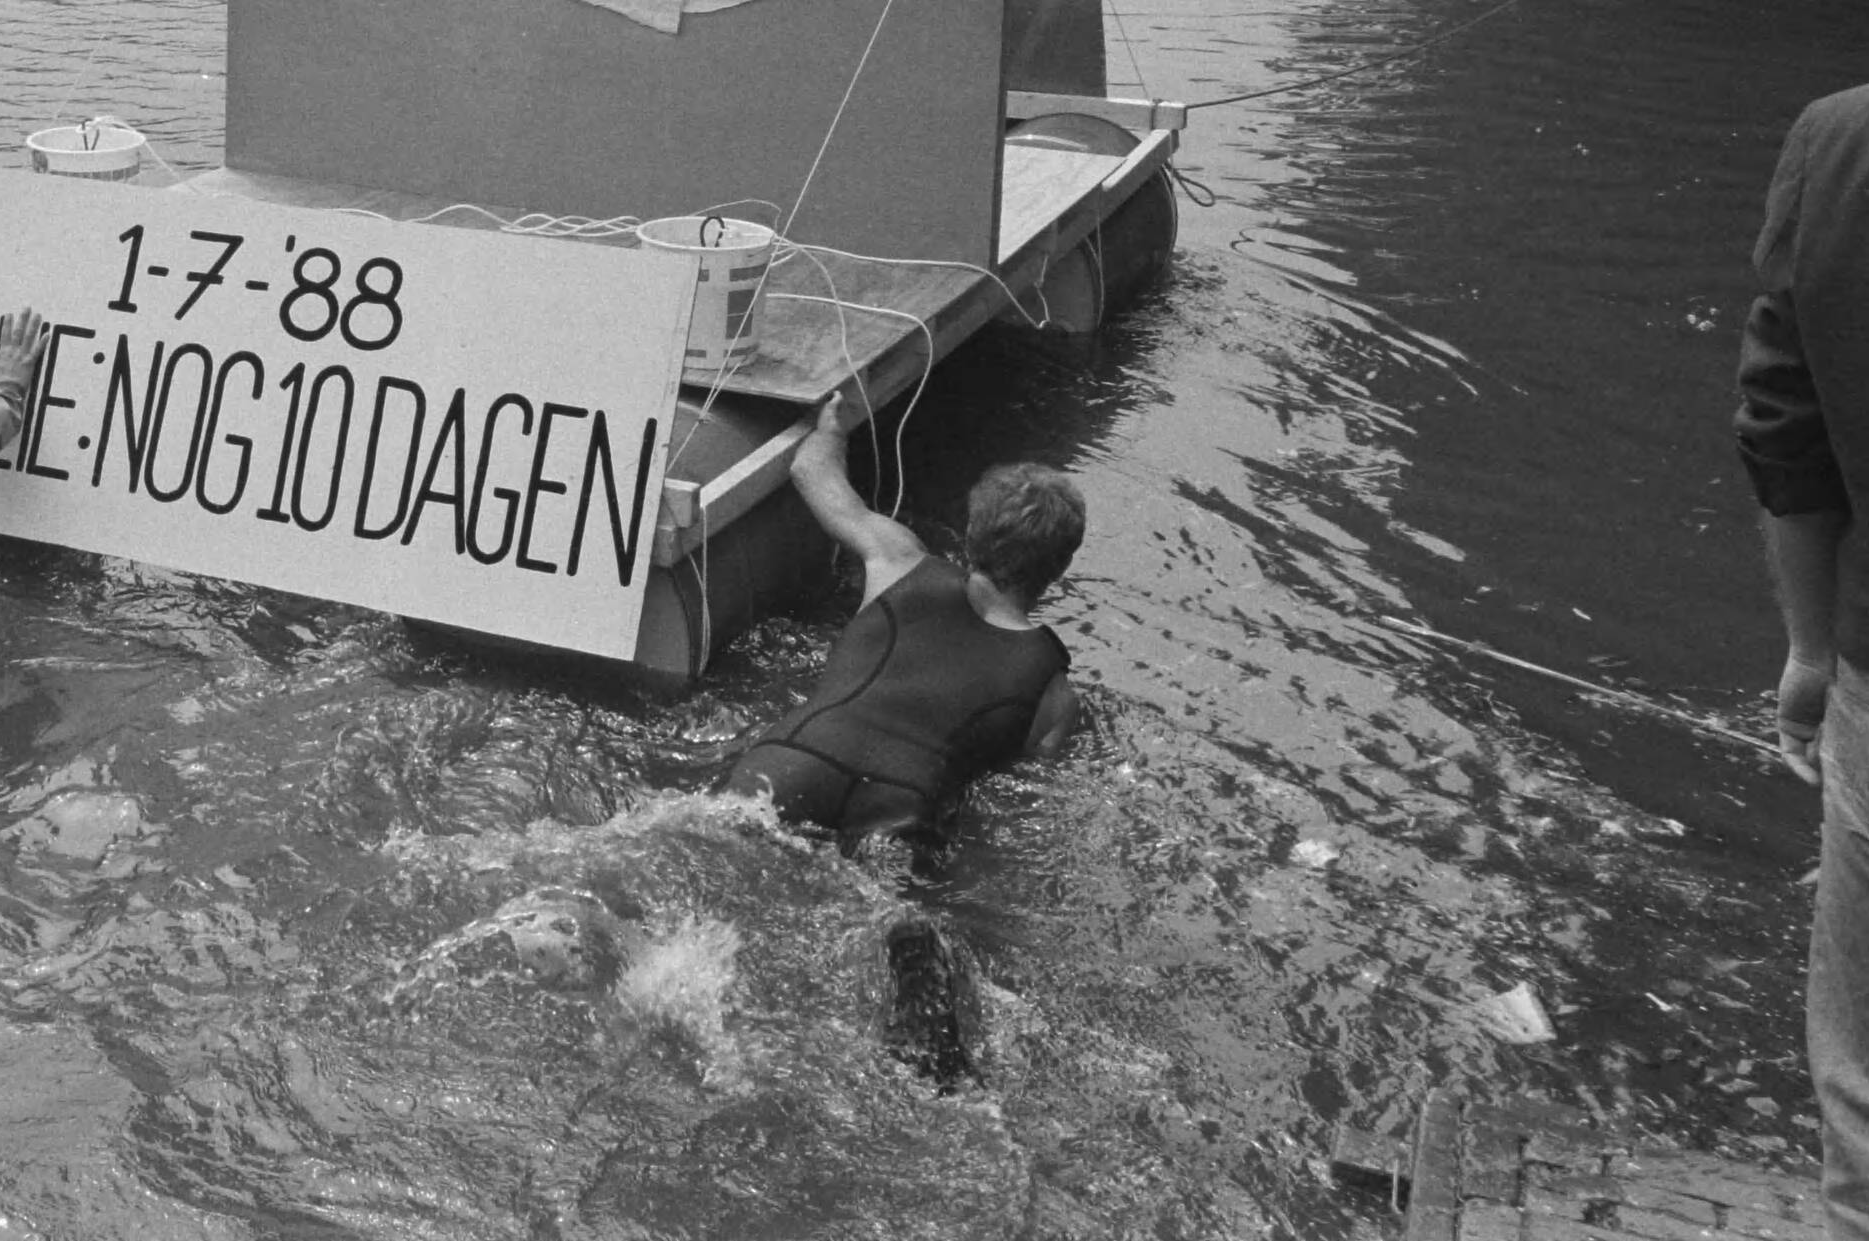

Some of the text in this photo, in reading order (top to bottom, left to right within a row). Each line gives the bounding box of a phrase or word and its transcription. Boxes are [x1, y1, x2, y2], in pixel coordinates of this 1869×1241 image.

[108, 224, 404, 352] 1-7-'88
[91, 334, 265, 515] NOG
[256, 362, 355, 532] 10
[353, 376, 658, 587] DAGEN
